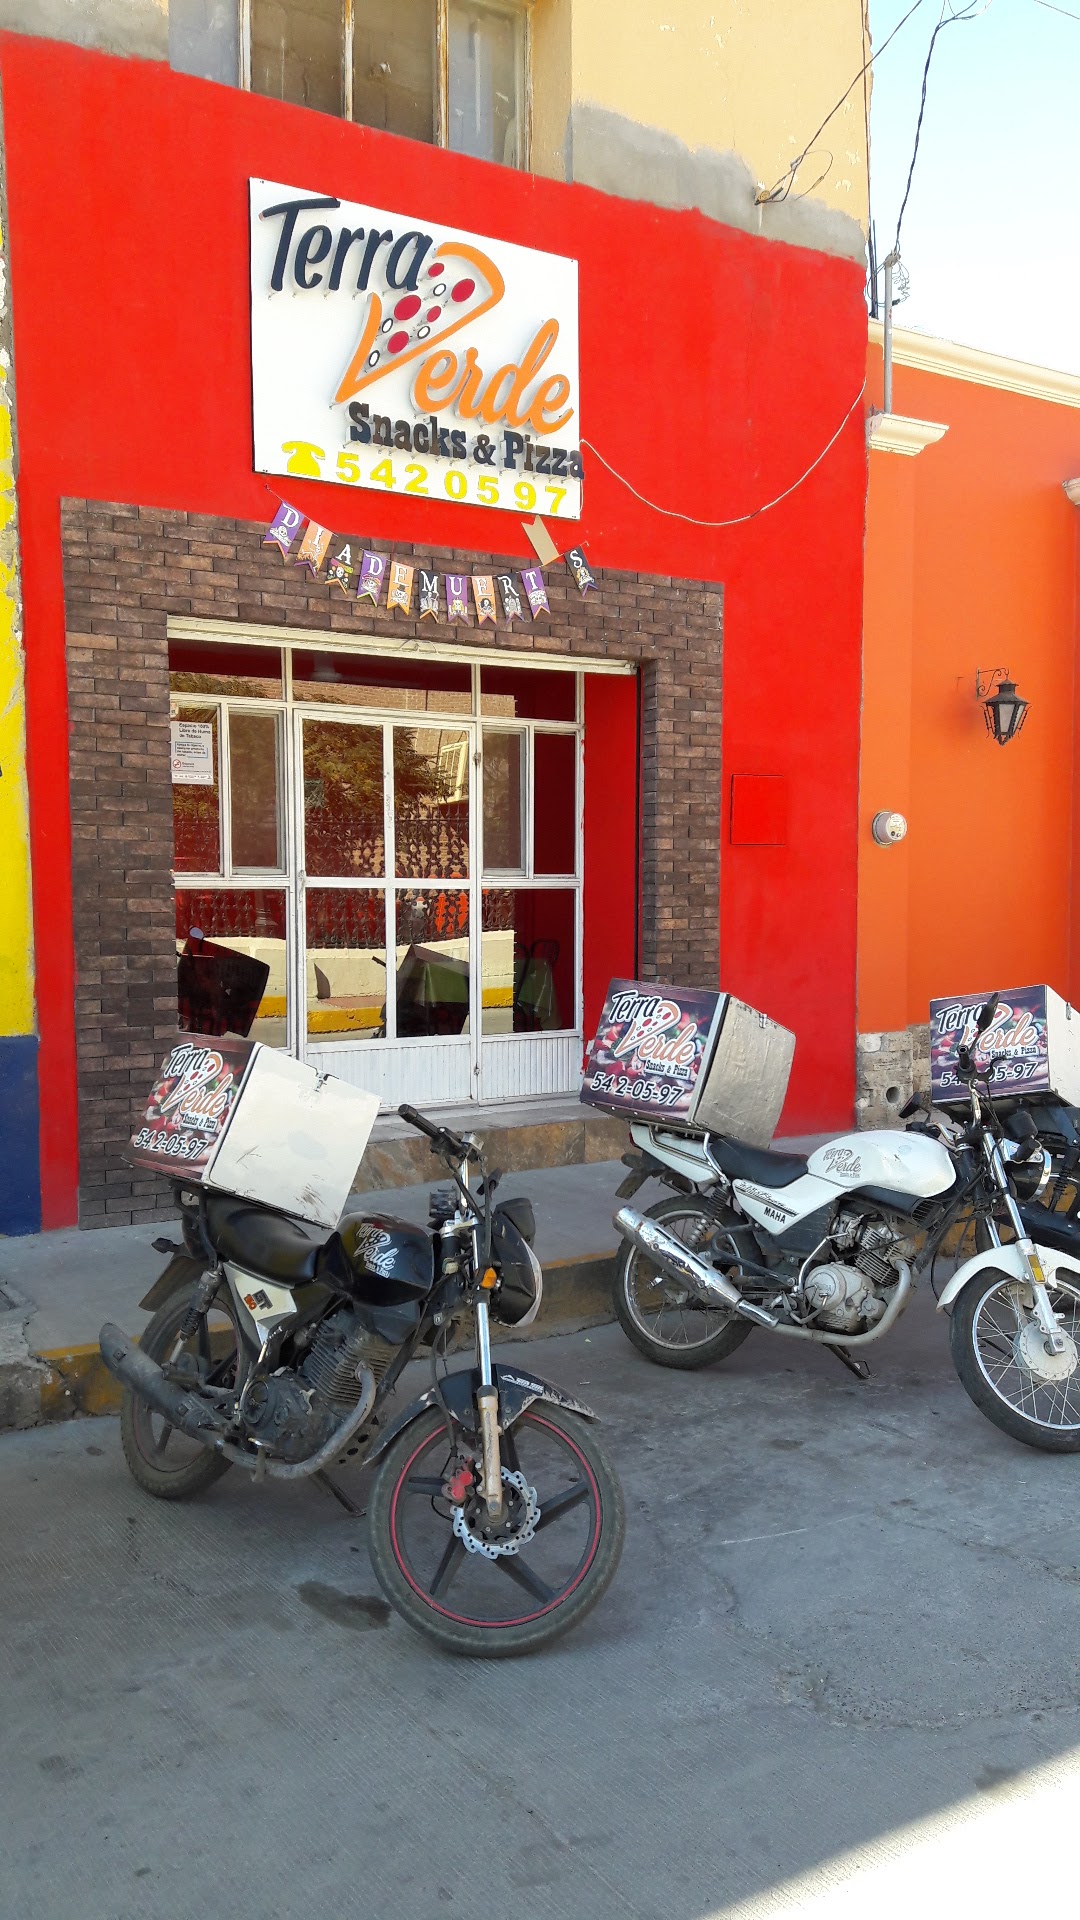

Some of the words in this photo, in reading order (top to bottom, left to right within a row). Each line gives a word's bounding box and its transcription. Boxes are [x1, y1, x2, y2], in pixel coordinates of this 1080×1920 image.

[258, 197, 433, 291] Terra
[334, 241, 574, 435] Verde
[349, 401, 467, 459] Snacks
[472, 434, 496, 466] &
[503, 430, 584, 480] Pizza
[609, 991, 661, 1021] Terra
[614, 1002, 696, 1064] Verde
[162, 1053, 233, 1117] Verde
[165, 1044, 209, 1076] Terra
[825, 1149, 862, 1173] Verde
[353, 1231, 399, 1270] Verde
